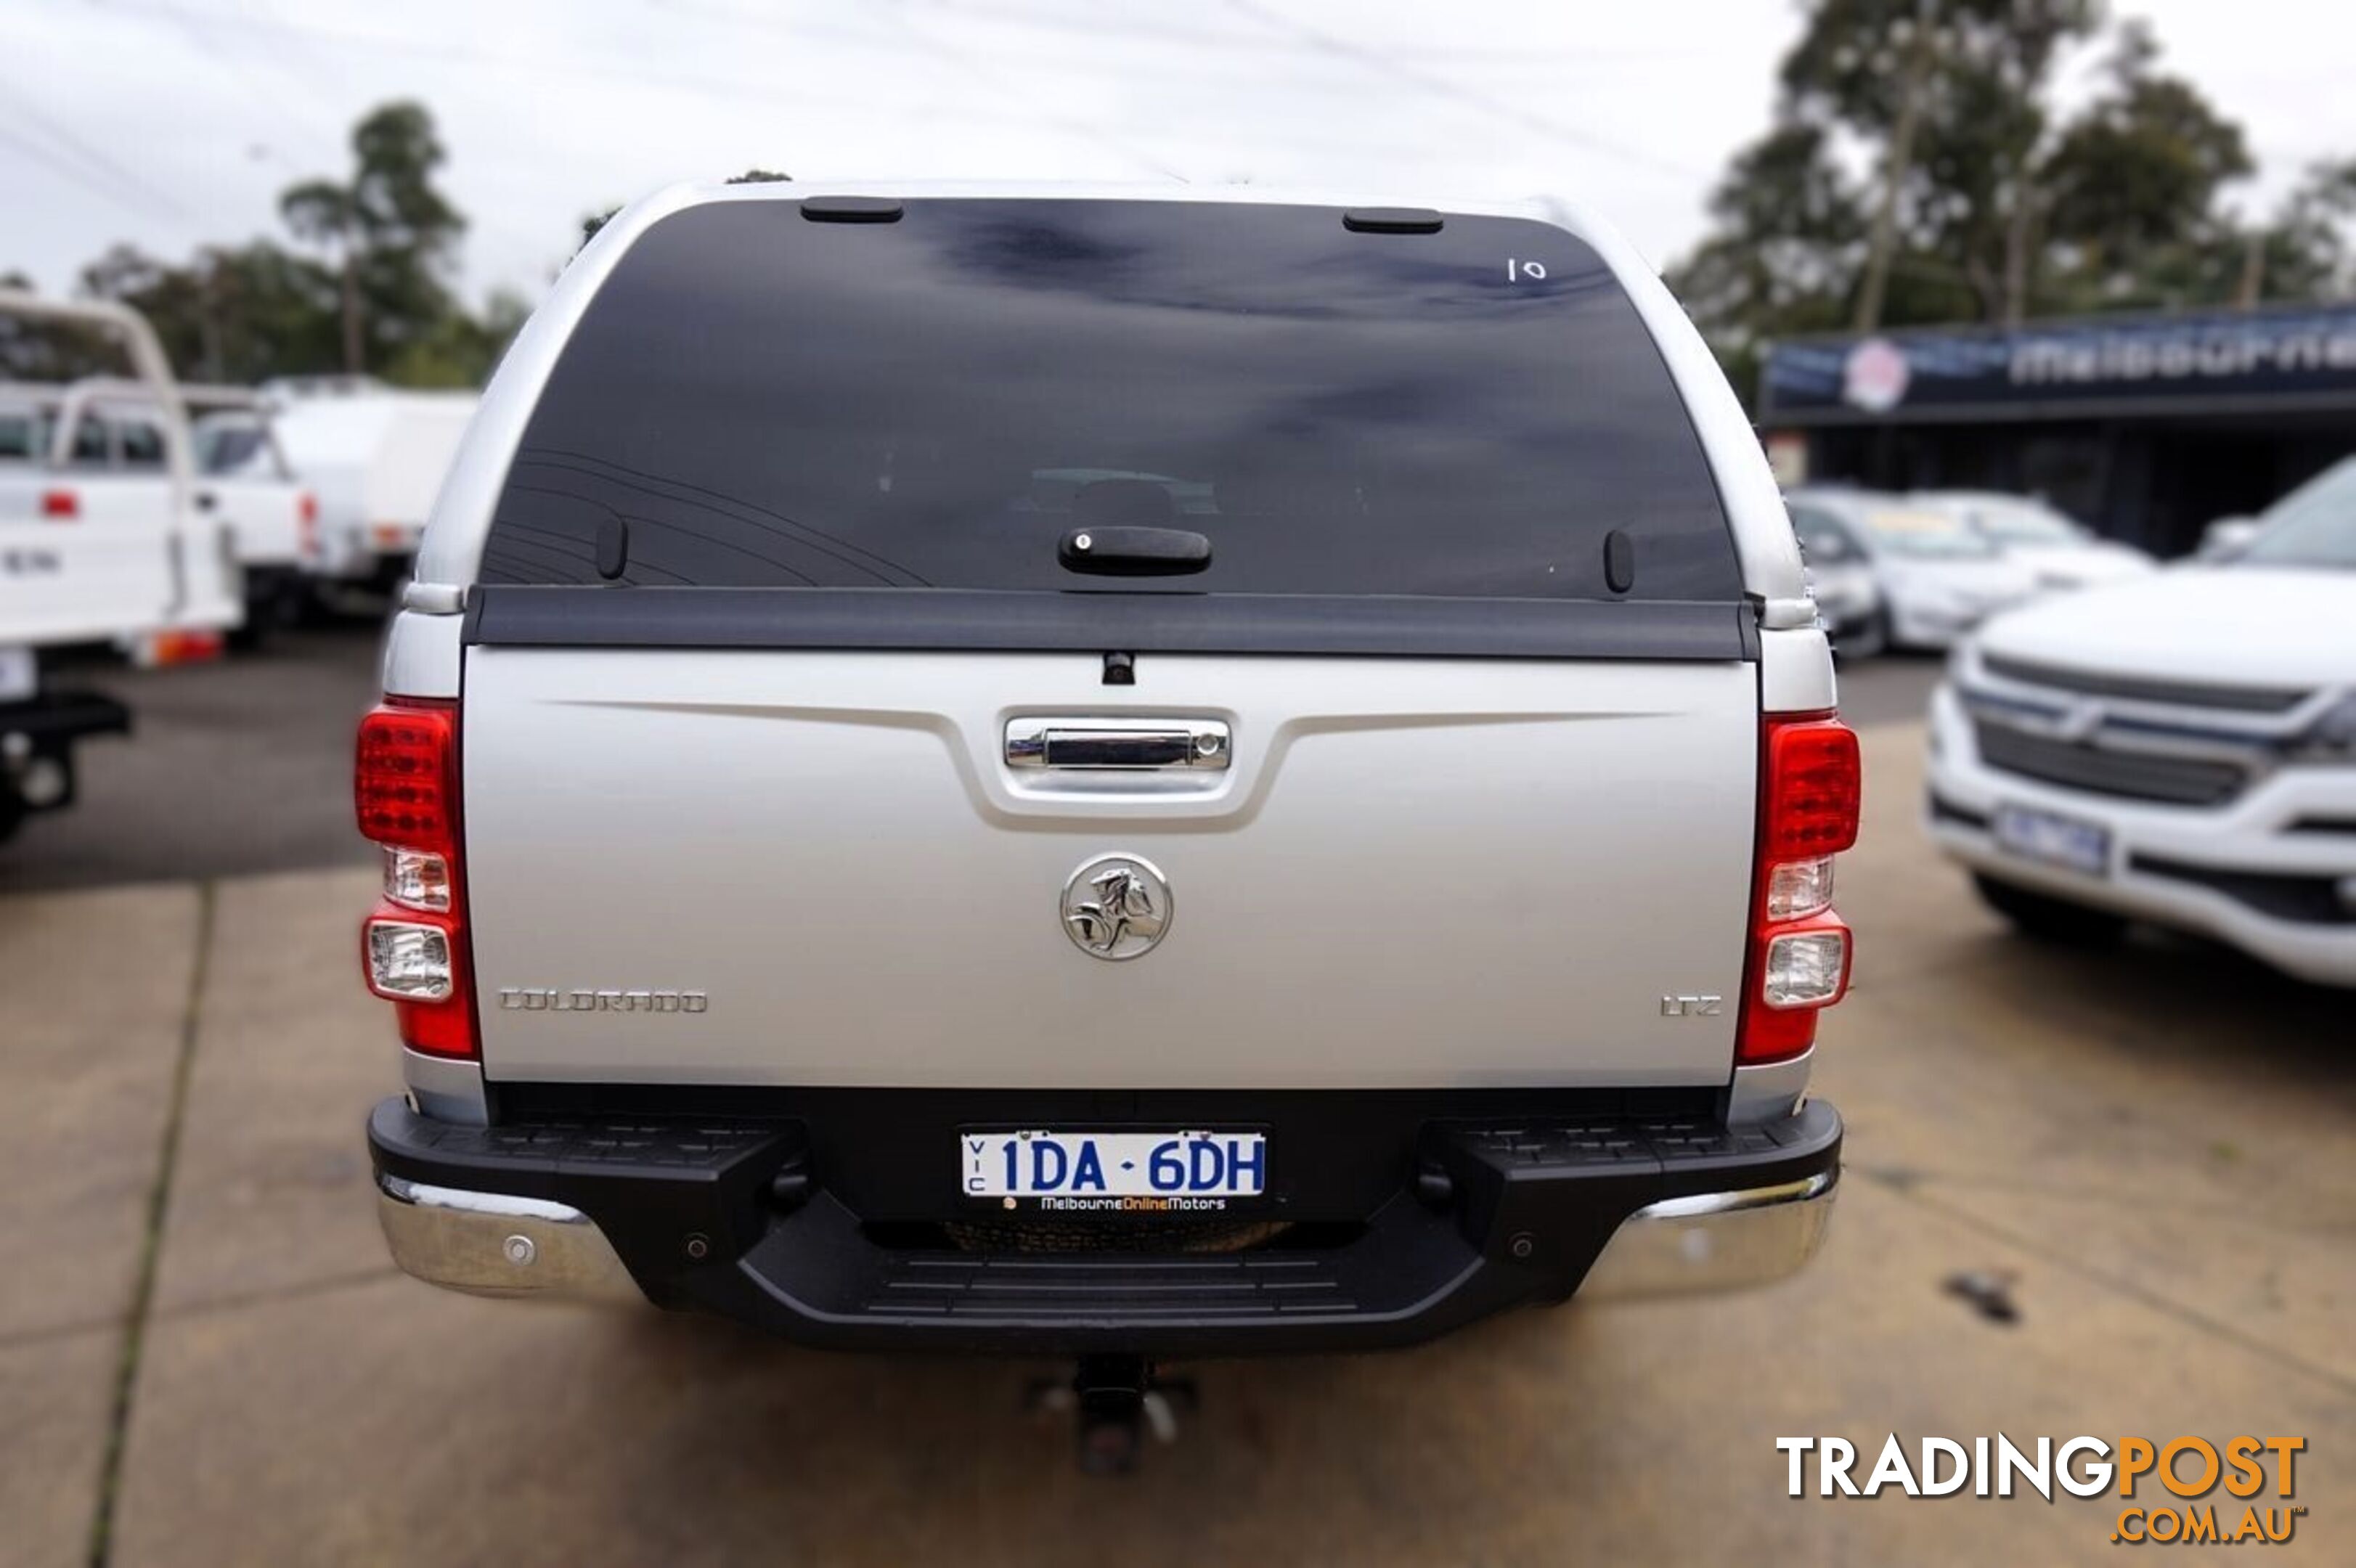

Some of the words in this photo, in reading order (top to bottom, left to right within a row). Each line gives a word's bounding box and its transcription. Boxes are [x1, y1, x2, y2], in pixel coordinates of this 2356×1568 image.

[1509, 258, 1546, 282] 10
[499, 988, 708, 1013] COLORADO
[1660, 995, 1721, 1016] LTZ
